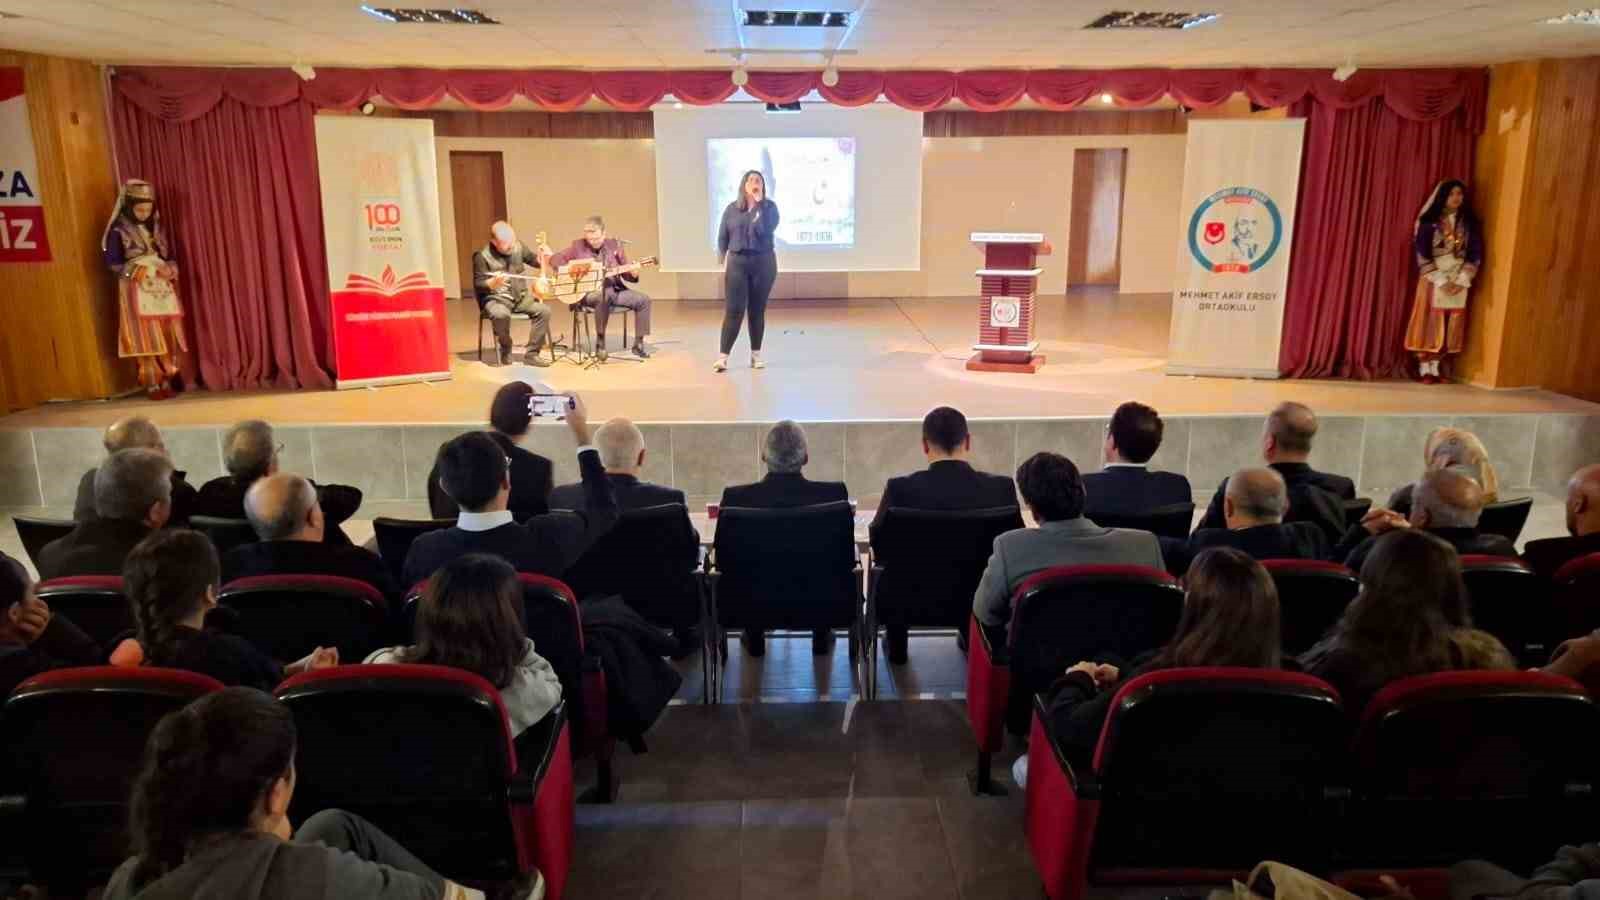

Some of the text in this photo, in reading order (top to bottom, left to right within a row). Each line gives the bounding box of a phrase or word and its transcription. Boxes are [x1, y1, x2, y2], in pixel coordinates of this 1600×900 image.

[1179, 290, 1219, 299] MEHMET
[1246, 291, 1278, 301] ERSOY
[1198, 302, 1256, 312] ORTAOKULU
